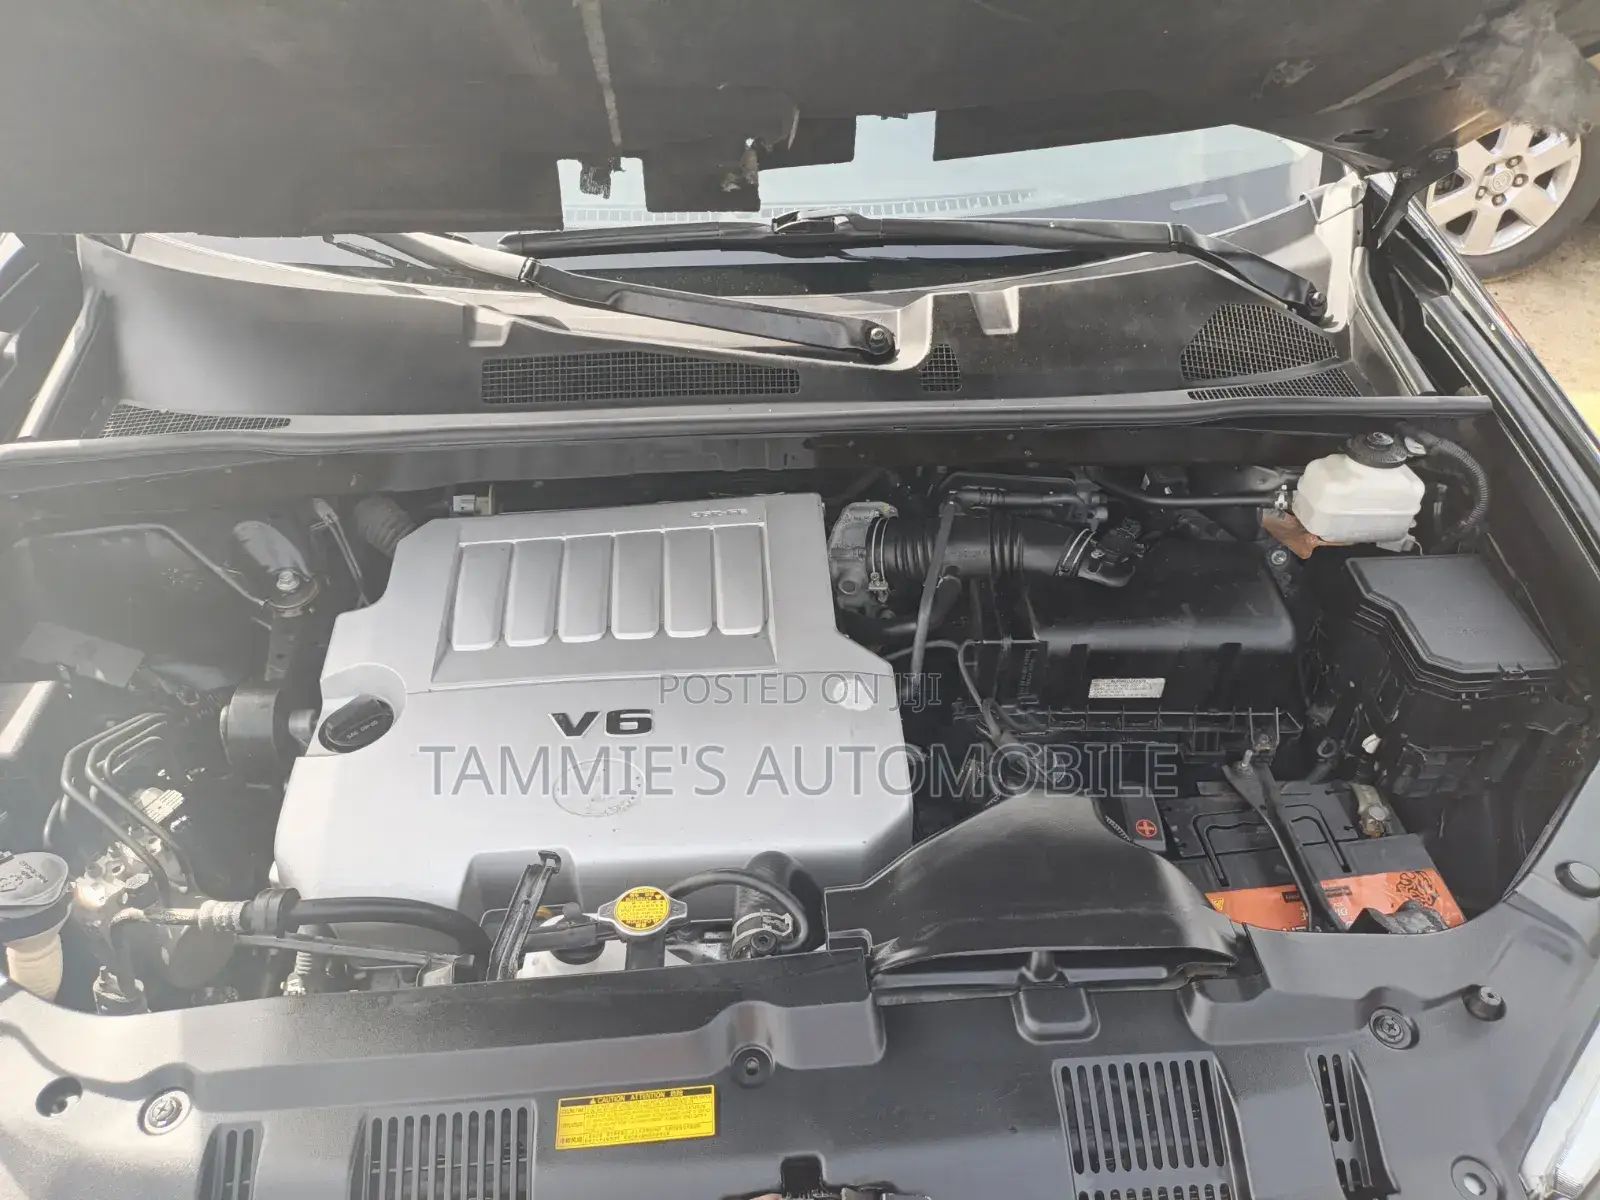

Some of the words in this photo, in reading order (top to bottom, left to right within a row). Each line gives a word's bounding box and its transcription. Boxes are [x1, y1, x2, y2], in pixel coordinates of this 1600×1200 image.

[548, 708, 654, 738] V6
[597, 1095, 625, 1104] CAUTION
[630, 1091, 665, 1100] ATTENTION
